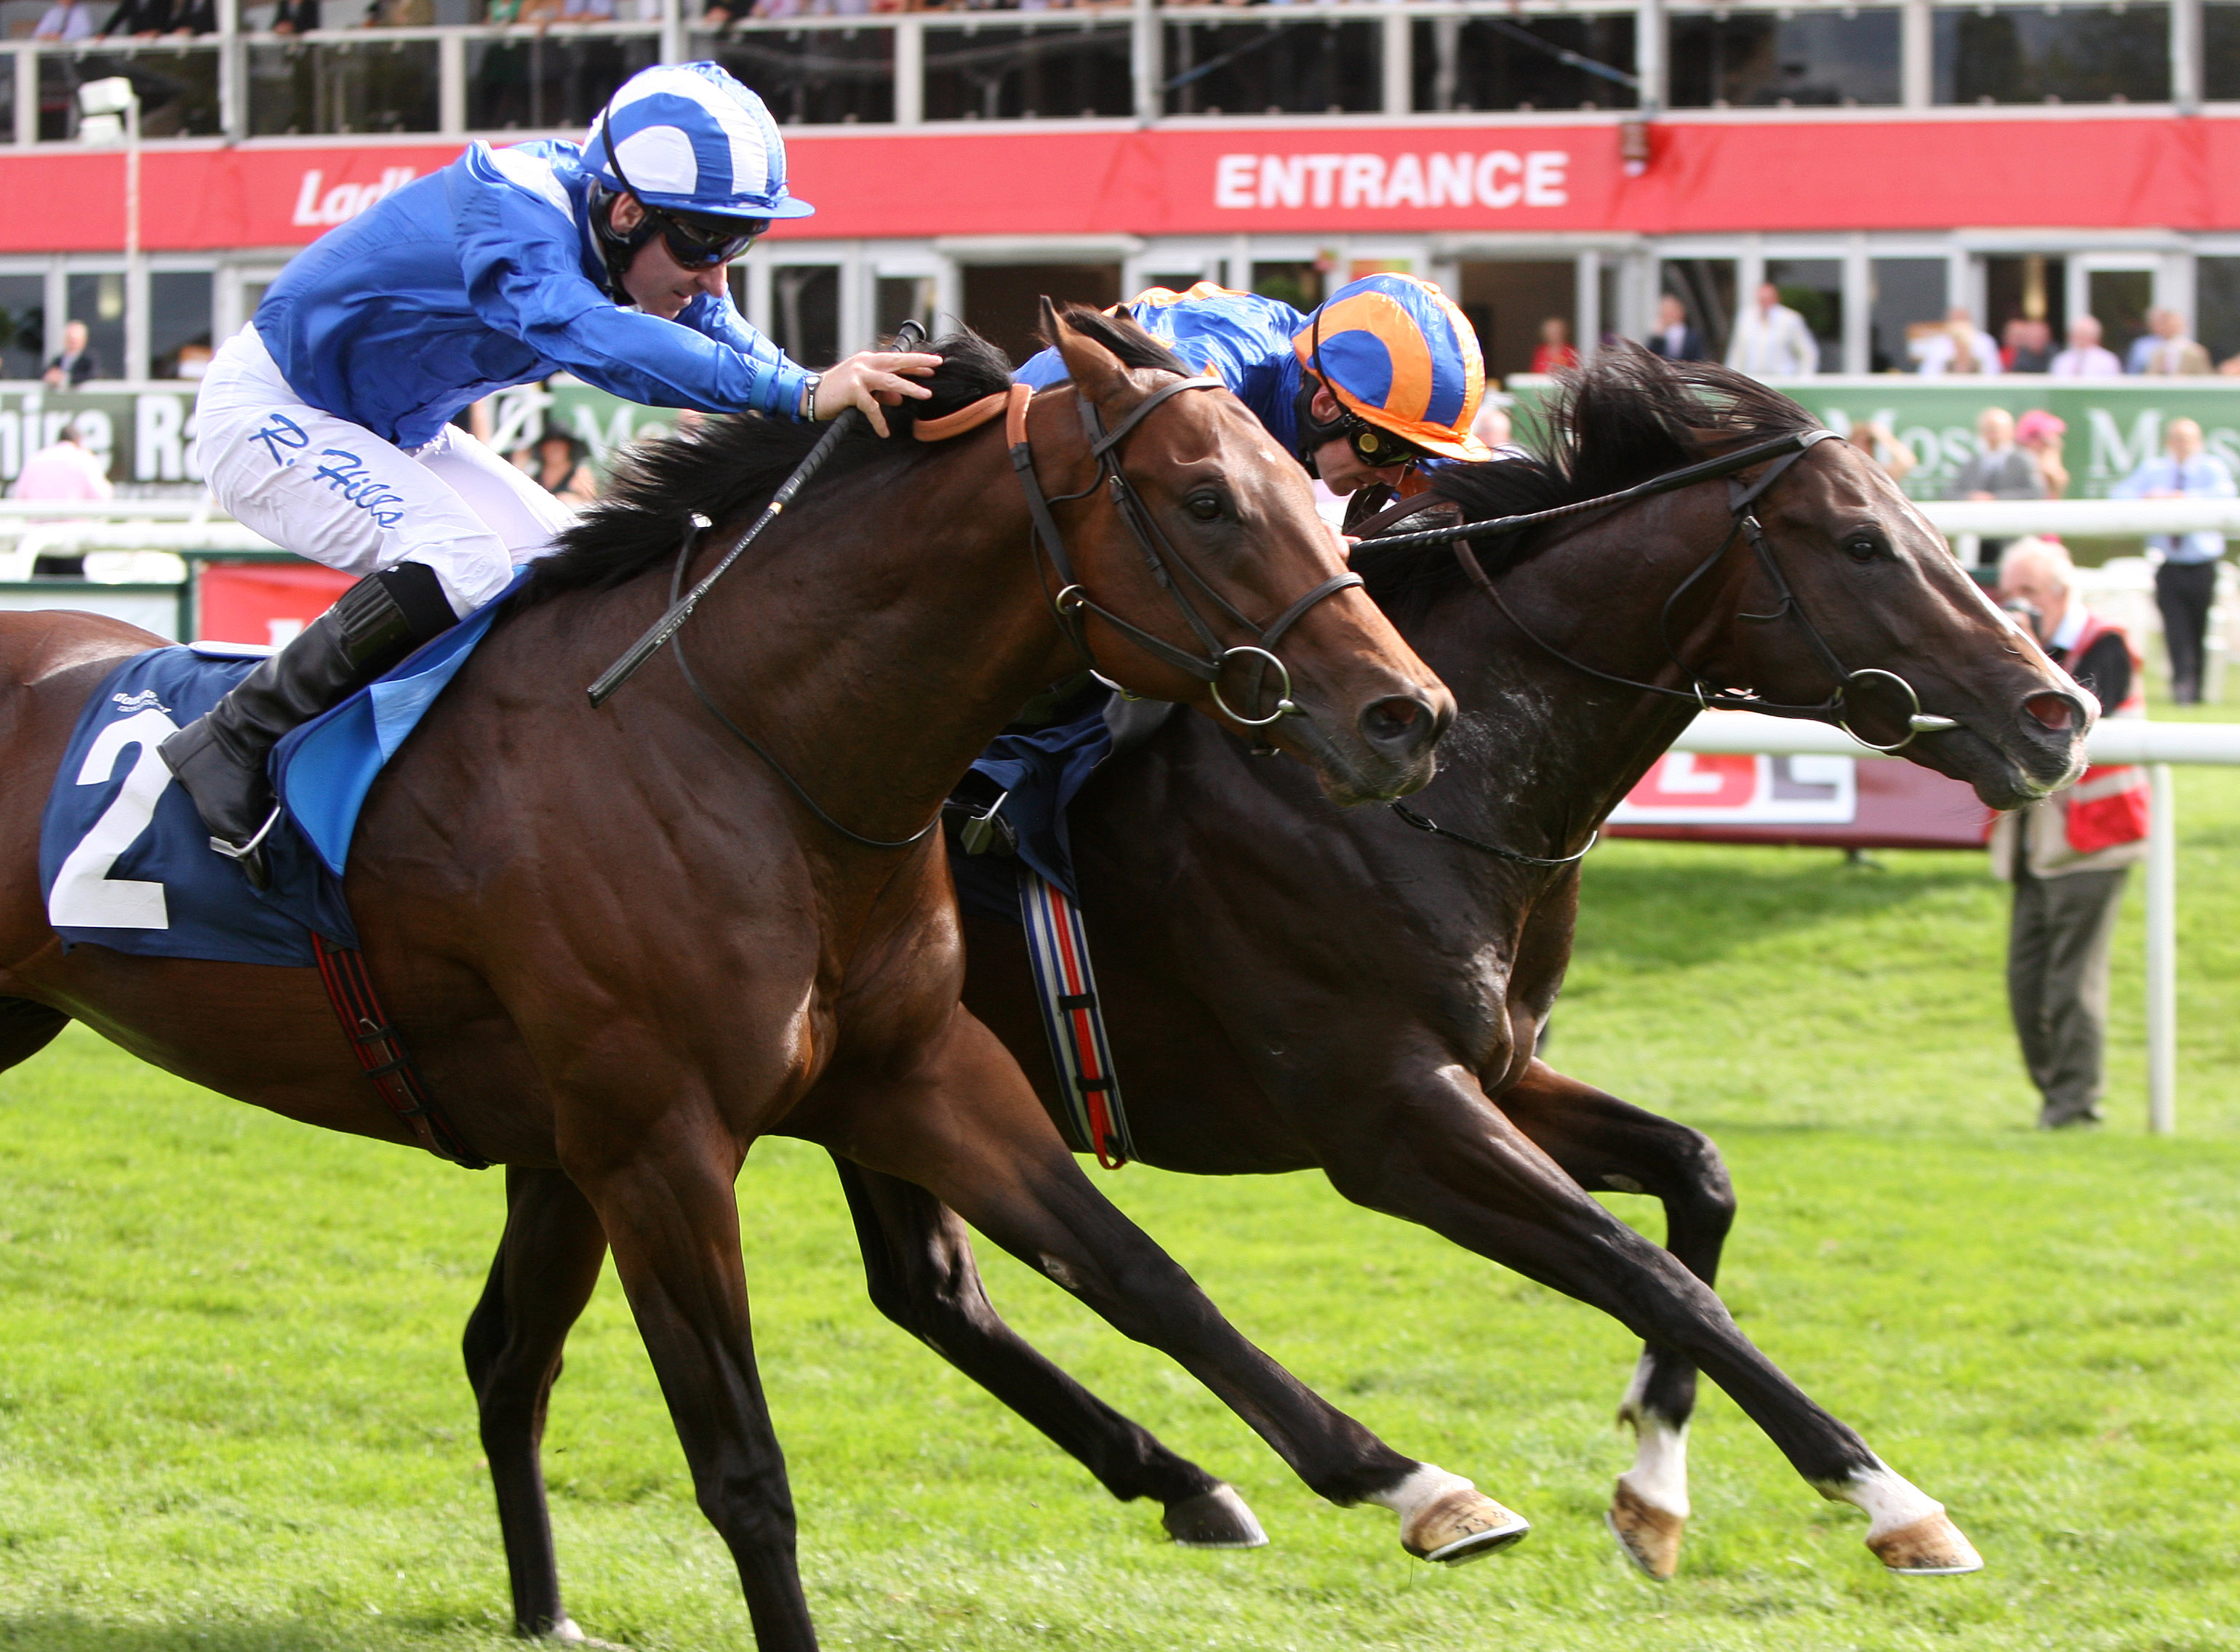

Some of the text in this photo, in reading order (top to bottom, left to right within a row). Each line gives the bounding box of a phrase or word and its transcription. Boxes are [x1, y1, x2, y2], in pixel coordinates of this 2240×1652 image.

[1214, 150, 1569, 210] ENTRANCE
[248, 412, 404, 529] R. Hills
[48, 708, 180, 930] 2
